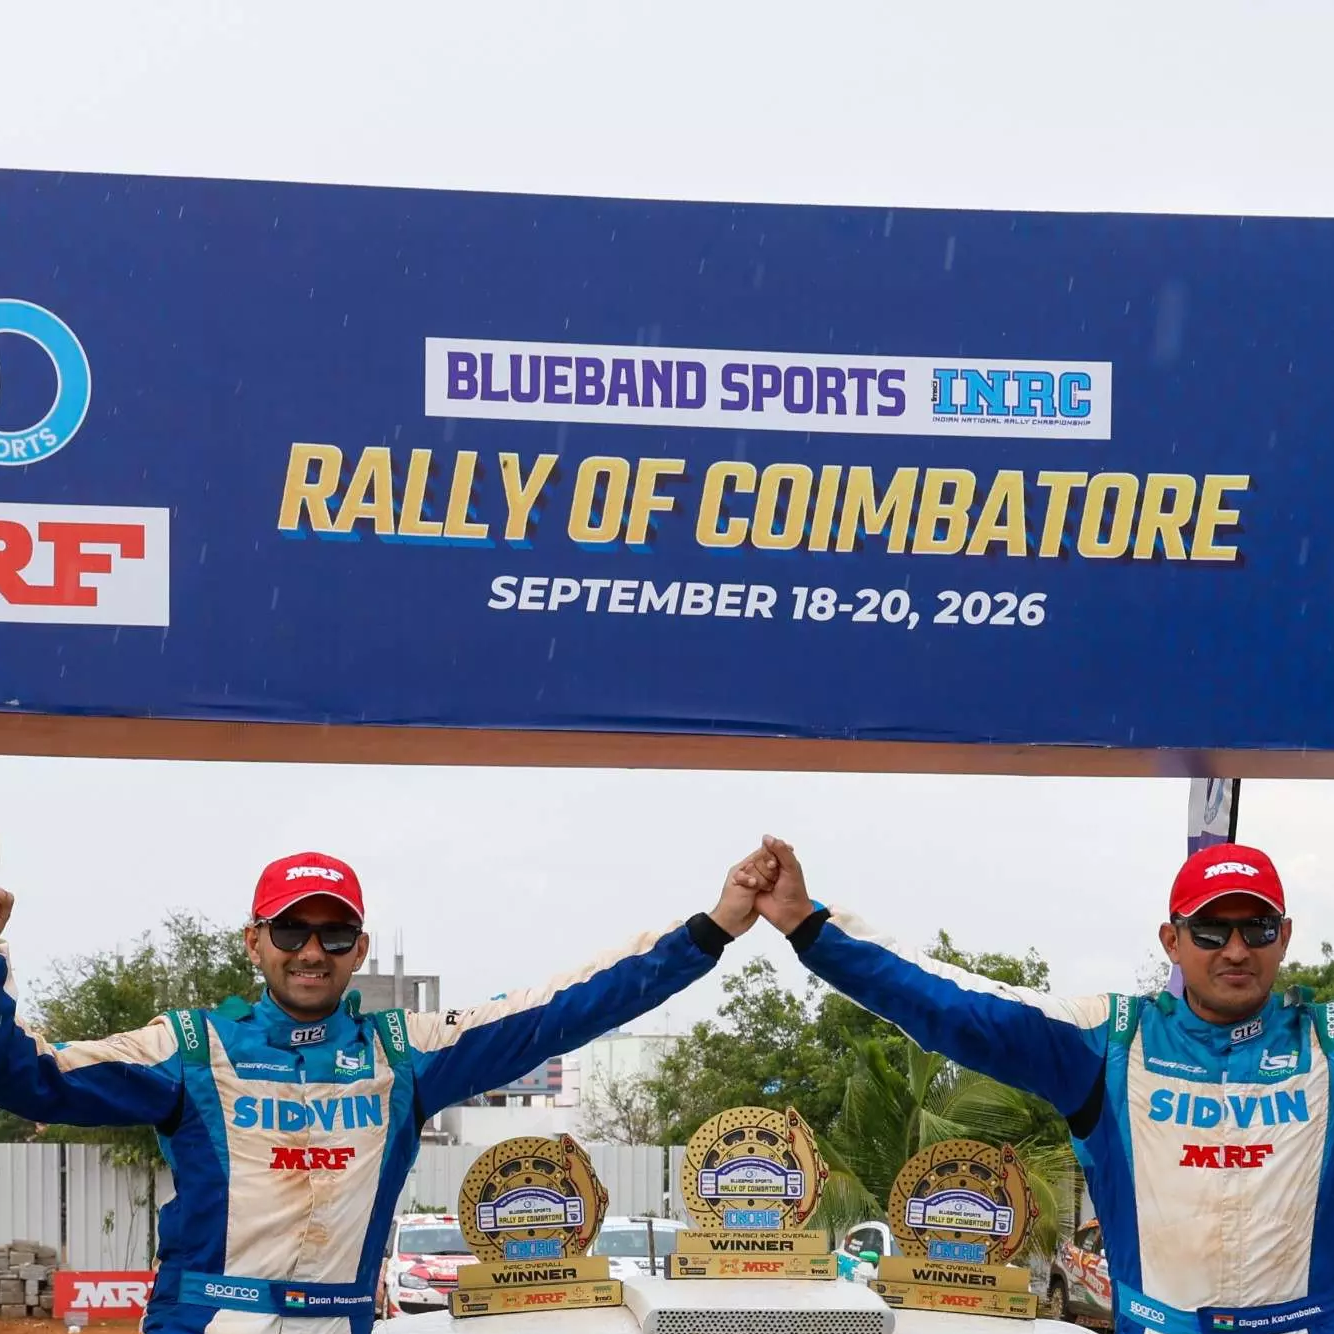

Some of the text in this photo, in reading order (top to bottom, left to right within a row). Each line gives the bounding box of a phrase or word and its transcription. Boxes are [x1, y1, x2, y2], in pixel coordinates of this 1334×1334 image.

[446, 350, 1091, 418] BLUEBAND SPORTS INRC
[277, 442, 1252, 563] RALLY OF COIMBATORE
[488, 574, 1048, 627] SEPTEMBER 18-20, 2026
[284, 866, 343, 882] MRF
[1204, 862, 1259, 879] MRF
[233, 1095, 383, 1132] SIDVIN
[1148, 1089, 1309, 1129] SIDVIN
[270, 1147, 355, 1170] MRF
[1180, 1143, 1274, 1168] MRF
[710, 1240, 794, 1251] WINNER
[491, 1268, 577, 1283] WINNER
[912, 1269, 996, 1286] WINNER
